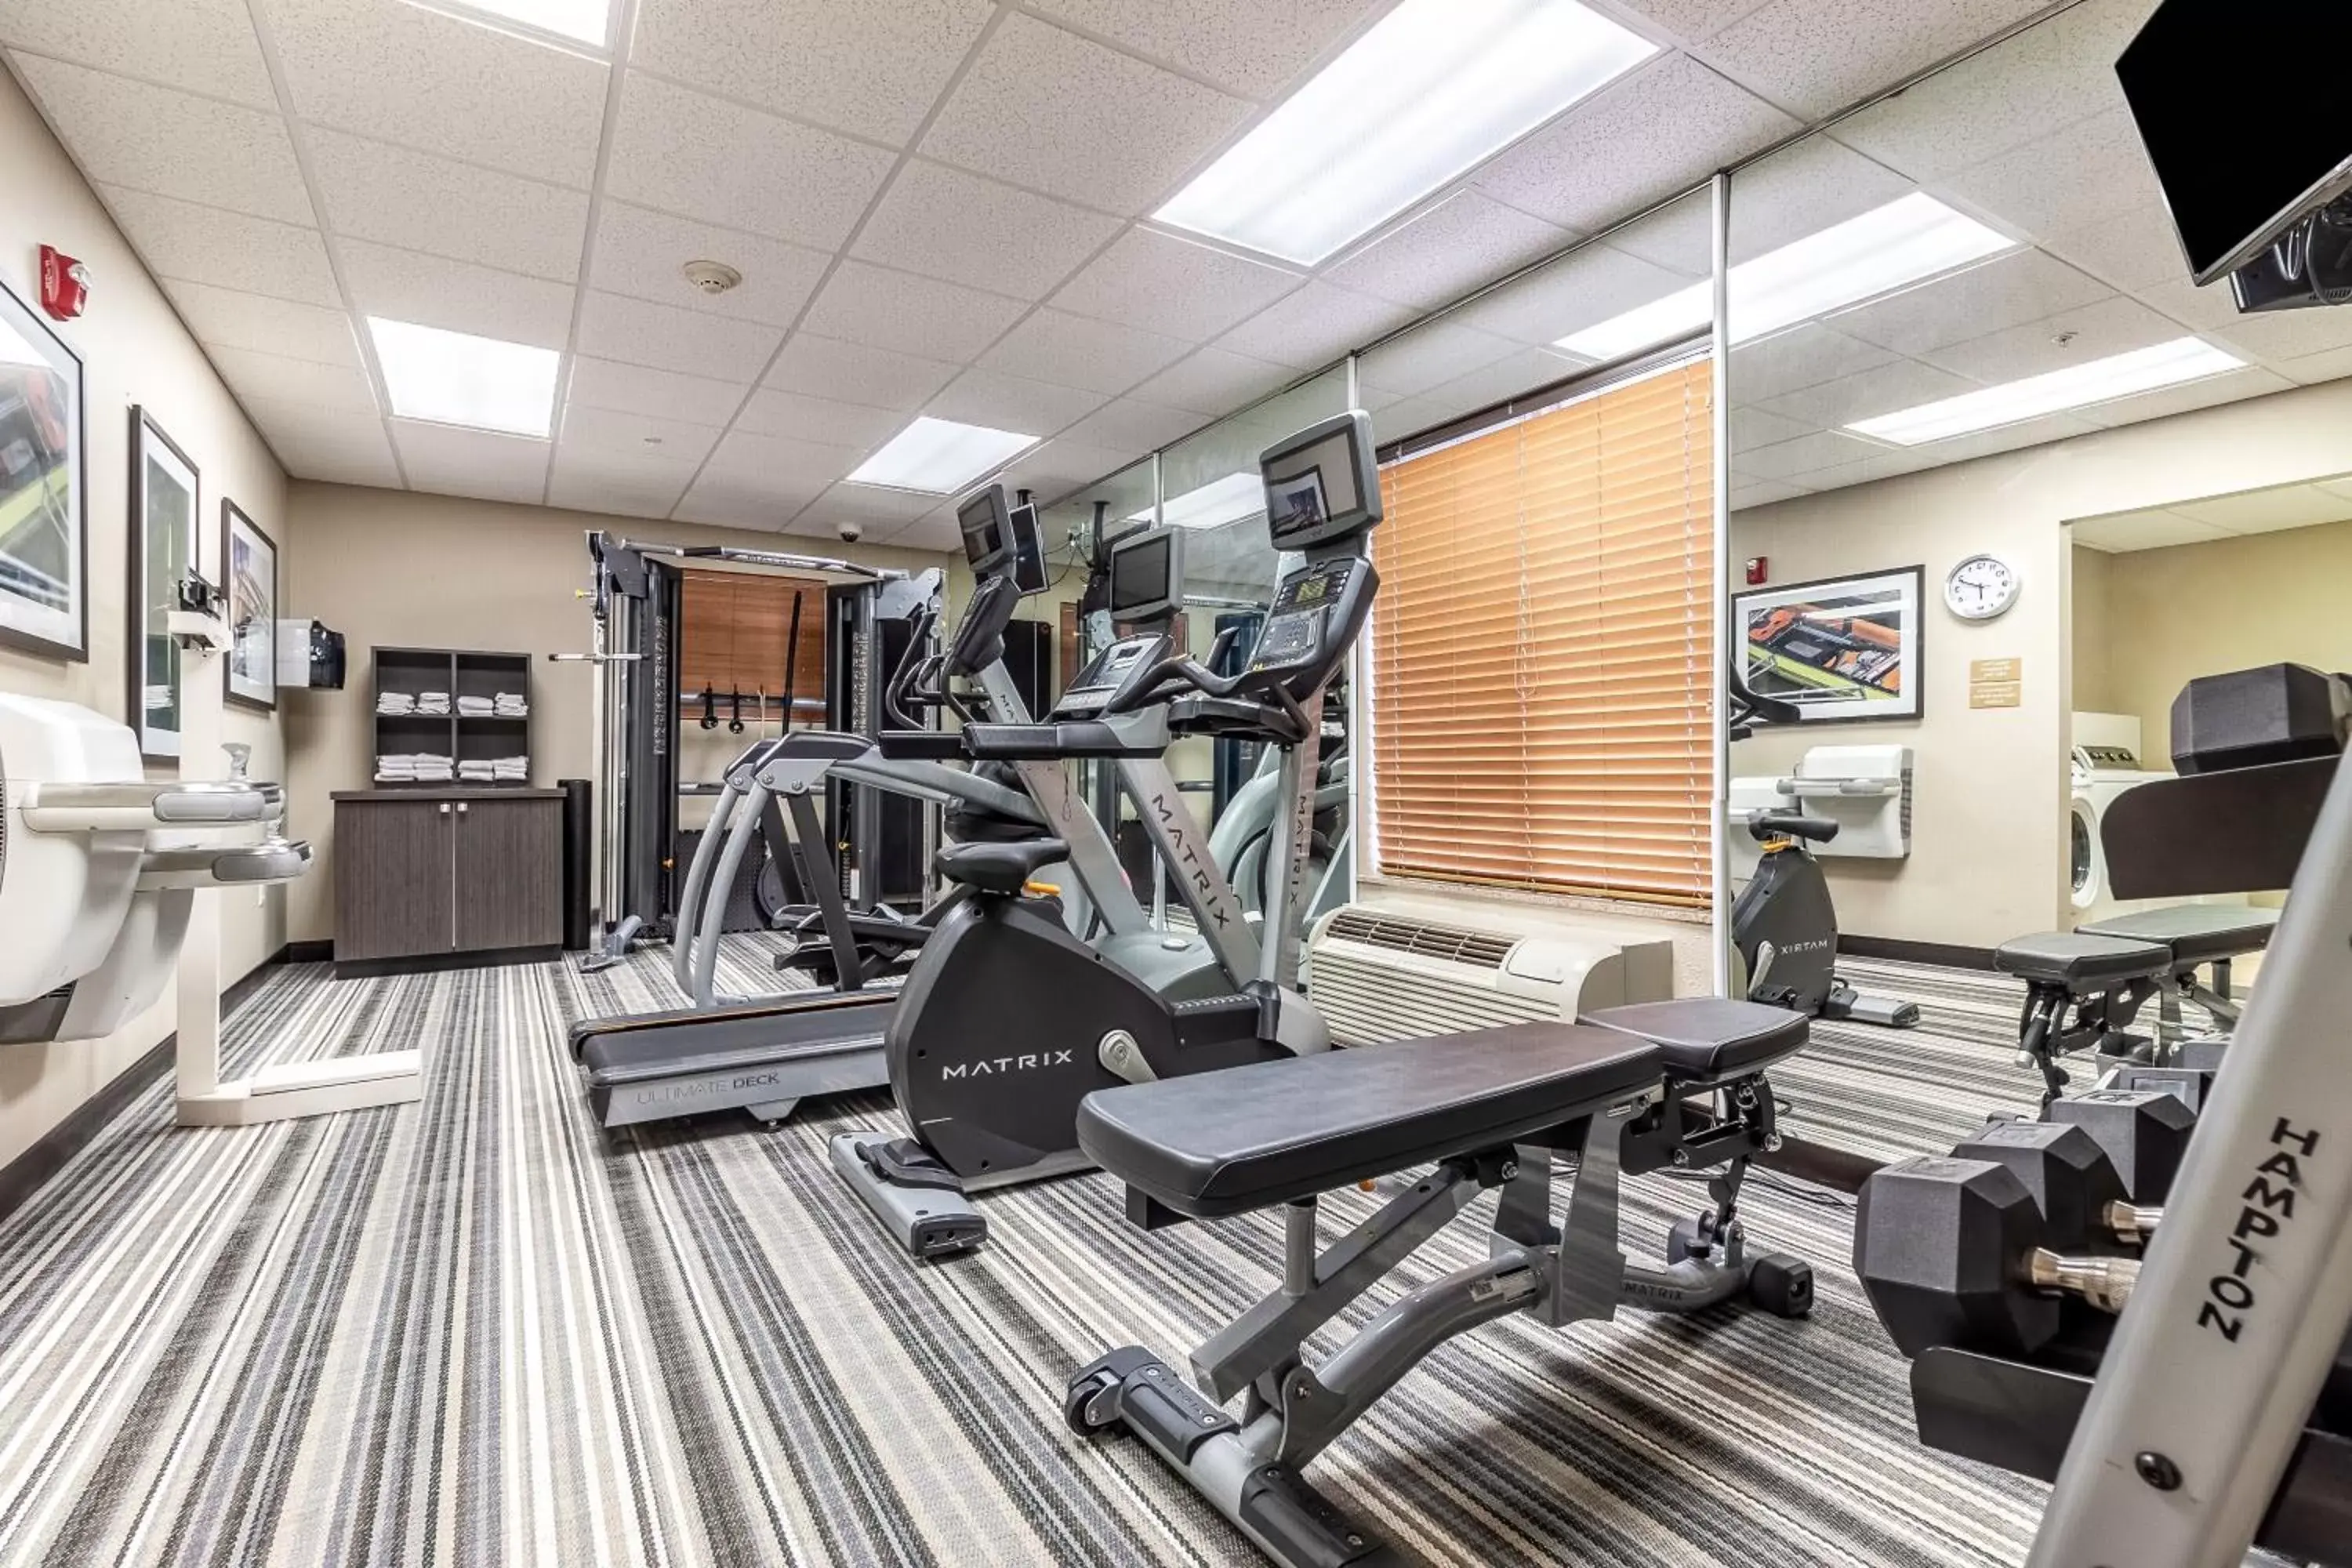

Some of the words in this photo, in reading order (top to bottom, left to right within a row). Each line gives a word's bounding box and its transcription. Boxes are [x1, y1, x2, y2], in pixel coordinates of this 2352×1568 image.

[1152, 793, 1230, 930] MATRIX
[1290, 796, 1307, 907] MATRIX
[637, 1080, 729, 1105] ULTIMATE
[732, 1071, 781, 1089] DECK
[942, 1048, 1073, 1081] MATRIX
[2197, 1116, 2321, 1343] HAMPTON
[1624, 1283, 1682, 1300] MATRIX
